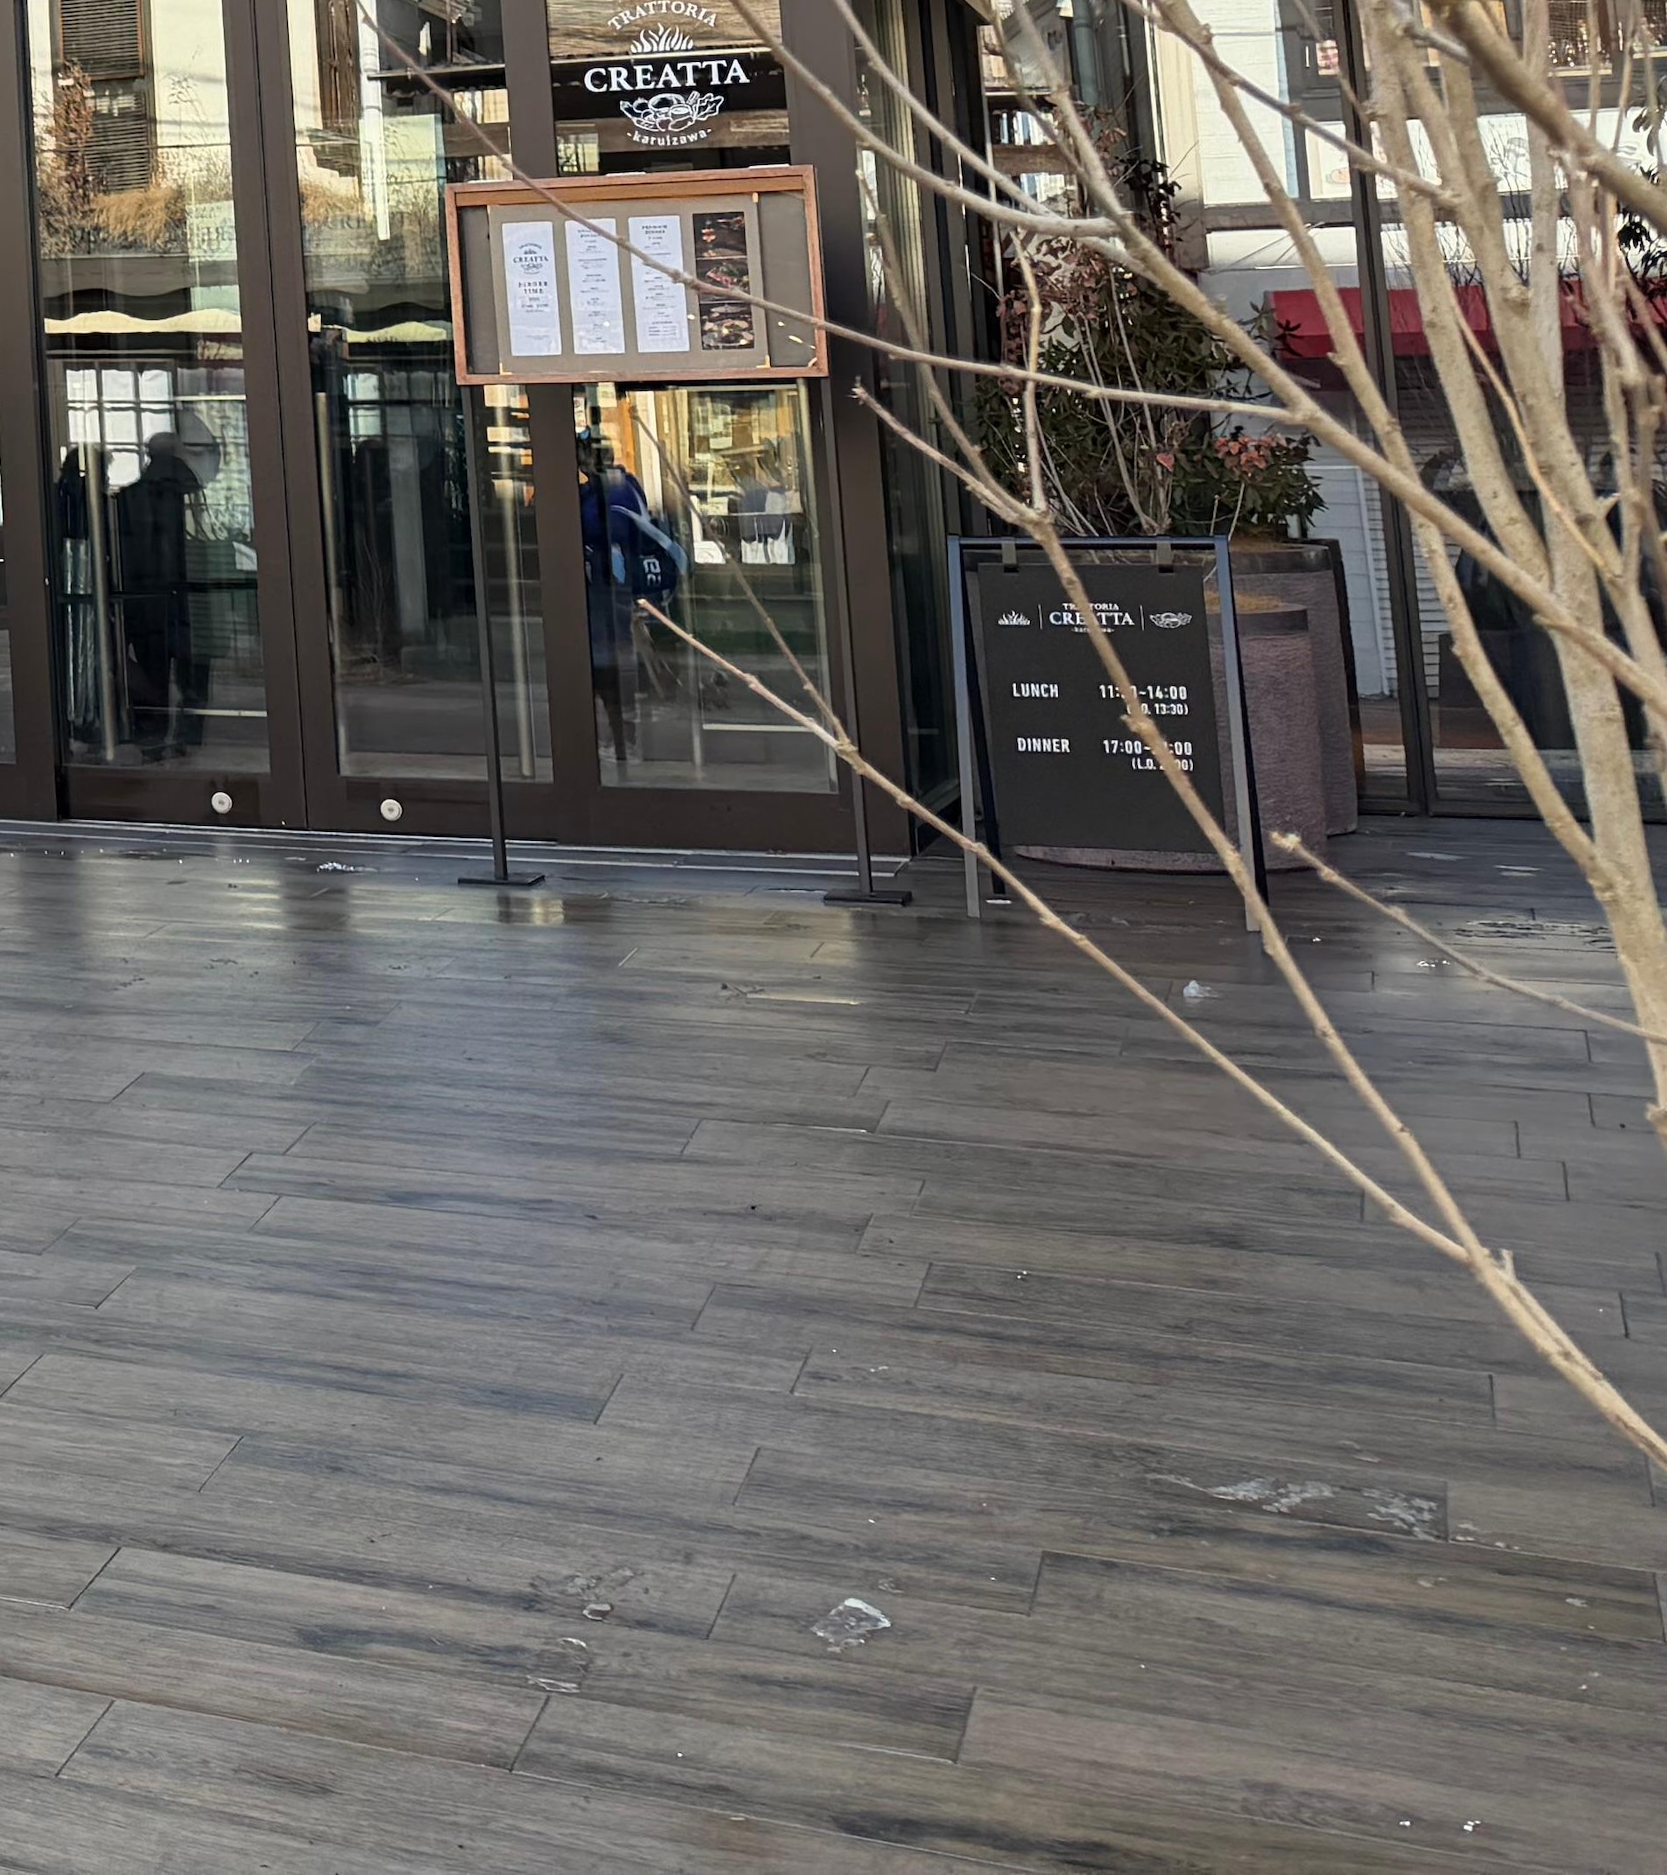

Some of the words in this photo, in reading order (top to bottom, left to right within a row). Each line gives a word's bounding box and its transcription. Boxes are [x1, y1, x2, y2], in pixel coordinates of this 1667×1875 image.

[607, 0, 717, 30] TRATTORIA
[583, 59, 750, 92] CREATTA
[1049, 611, 1135, 625] CRETTA
[1012, 683, 1059, 698] LUNCH
[1099, 684, 1188, 700] 11:0~14:00
[1153, 703, 1189, 716] 13:30)
[1017, 738, 1071, 753] DINNER
[1103, 739, 1193, 757] 17:00~:00
[1132, 757, 1157, 770] (L.O.
